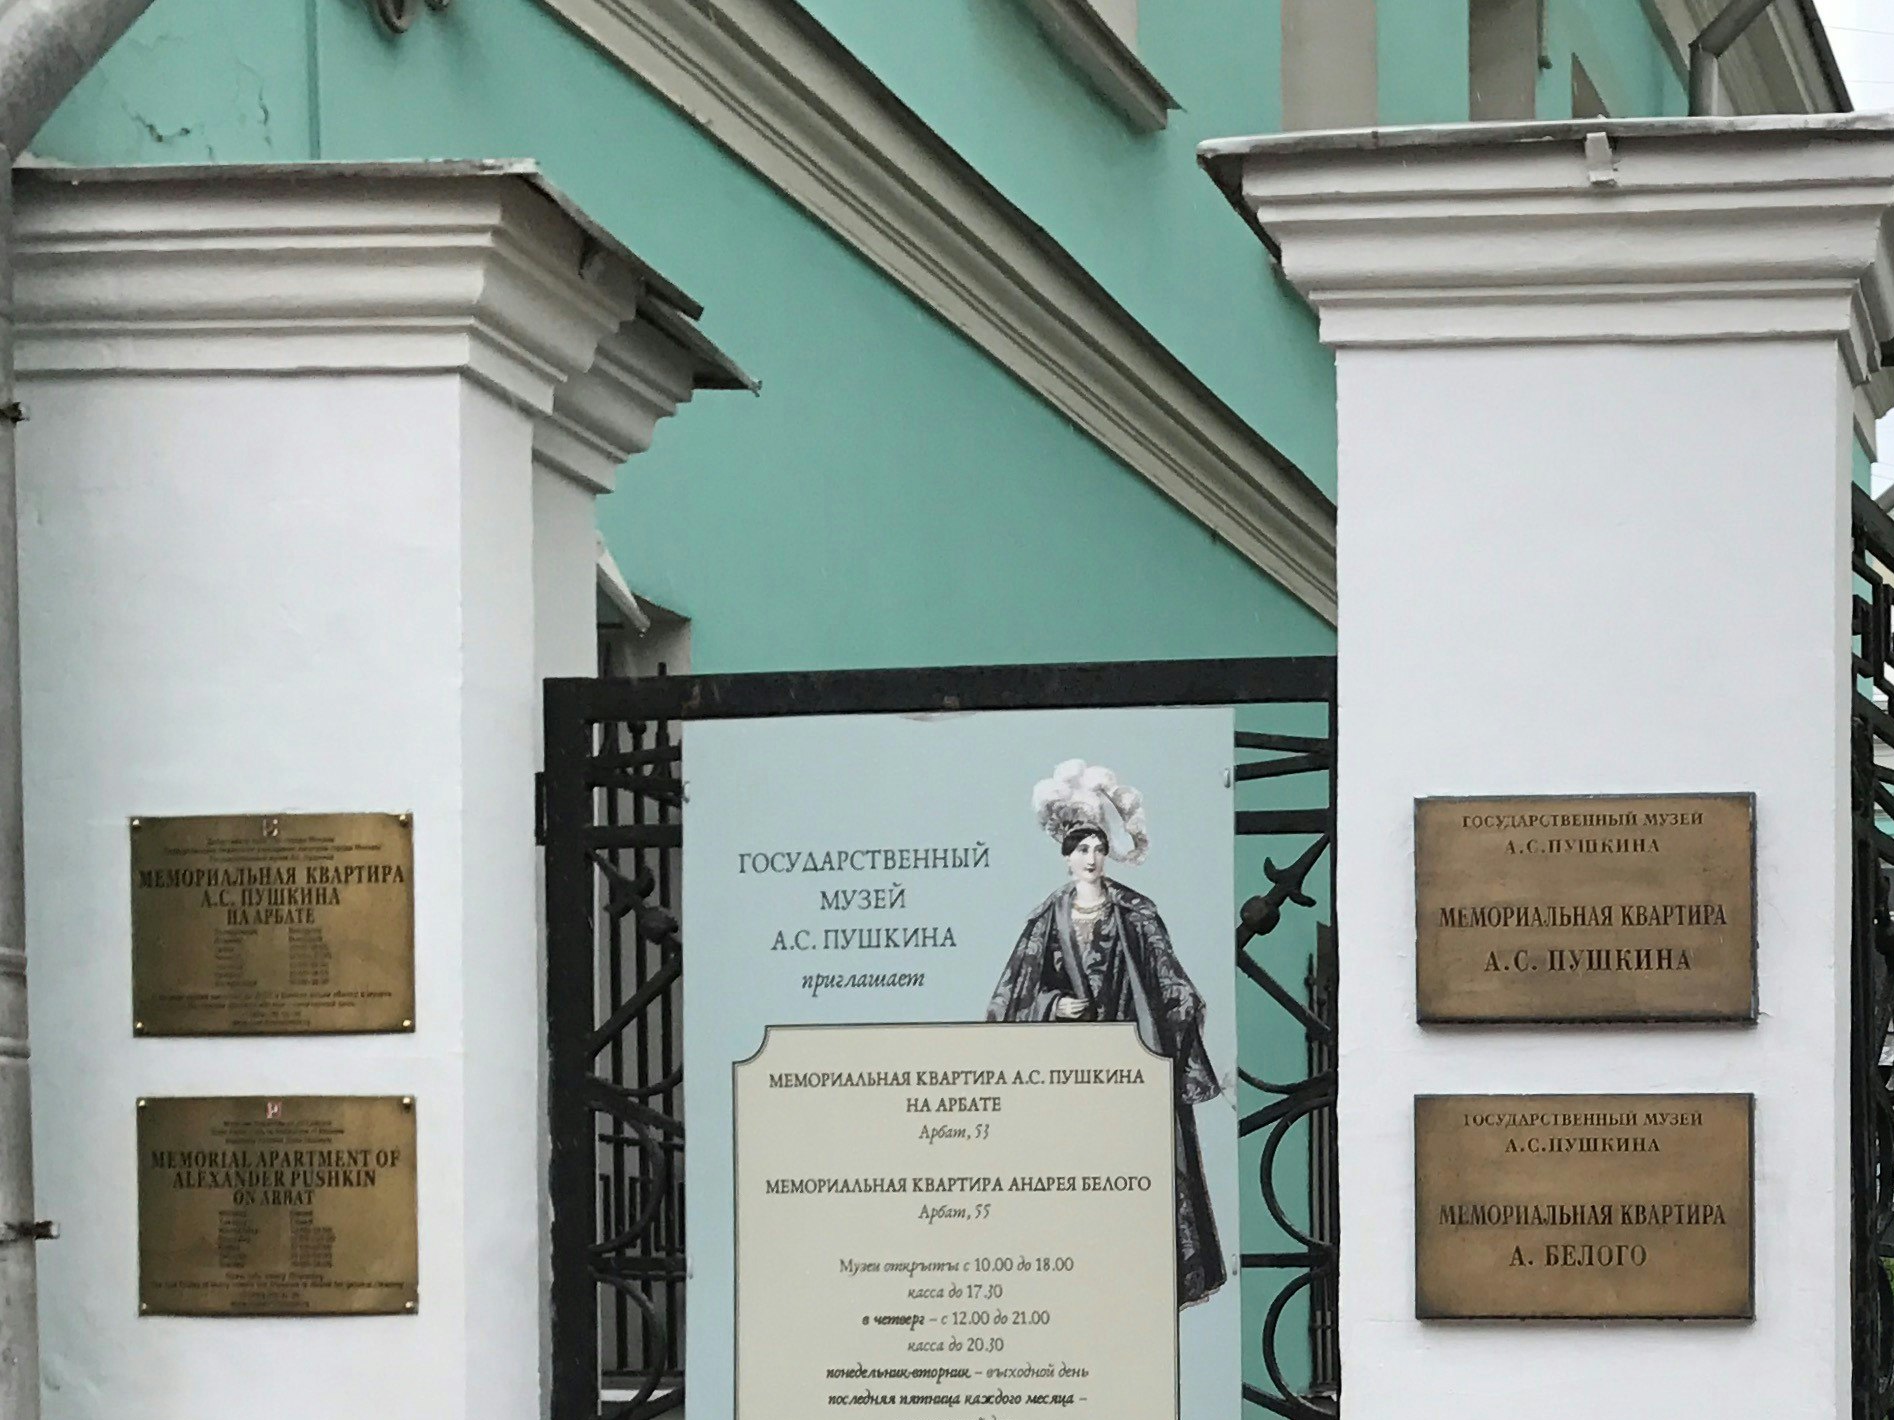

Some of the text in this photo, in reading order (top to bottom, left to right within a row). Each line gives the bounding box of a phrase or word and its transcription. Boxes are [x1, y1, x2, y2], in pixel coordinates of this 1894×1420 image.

[1462, 811, 1704, 829] ГОСУДАРСТВЕННЫЙ МУЗЕЙ
[738, 841, 990, 873] ГОСУДАРСТВЕННЫЙ
[138, 864, 405, 889] МЕМОРИАЛЬНАЯ КВАРТИРА
[241, 886, 341, 906] ПУШКИНА
[820, 882, 906, 911] МУЗЕЙ
[227, 907, 316, 926] НА АРБАТЕ
[1438, 904, 1728, 929] МЕМОРИАЛЬНАЯ КВАРТИРА
[770, 926, 957, 951] А.С. ПУШКИНА
[1484, 948, 1692, 973] А.С. ПУШКИНА
[801, 971, 925, 998] приглашает
[769, 1069, 1145, 1088] МЕМОРИАЛЬНАЯ КВАРТИРА А.С. ПУШКИНА
[906, 1097, 1002, 1113] НА АРБАТЕ
[1464, 1110, 1703, 1128] ГОСУДАРСТВЕННЫЙ МУЗЕЙ
[919, 1124, 991, 1144] Арбат, 53
[150, 1148, 402, 1170] MEMORIAL APARTMENT OF
[172, 1169, 377, 1189] ALEXANDER PUSHKIN
[765, 1175, 1152, 1195] МЕМОРИАЛЬНАЯ КВАРТИРА АНДРЕЯ БЕЛОГО
[232, 1189, 316, 1206] ON ARBAT
[918, 1203, 992, 1224] Арбат, 55
[1438, 1203, 1727, 1227] МЕМОРИАЛЬНАЯ КВАРТИРА
[884, 1260, 960, 1278] открыты
[974, 1257, 1013, 1272] 10.00
[1016, 1254, 1031, 1272] до
[1035, 1256, 1075, 1272] 18.00
[1508, 1244, 1647, 1268] А. БЕЛОГО
[907, 1282, 1003, 1300] касса до 17.30
[873, 1314, 925, 1331] четверг
[951, 1310, 990, 1326] 12.00
[993, 1308, 1008, 1325] до
[1011, 1310, 1050, 1325] 21.00
[907, 1335, 1004, 1353] касса до 20.30
[986, 1362, 1055, 1379] выходной
[1058, 1361, 1089, 1379] день
[828, 1388, 896, 1406] последняя
[899, 1394, 961, 1408] пятница
[964, 1387, 1022, 1405] каждого
[1025, 1393, 1075, 1408] месяца
